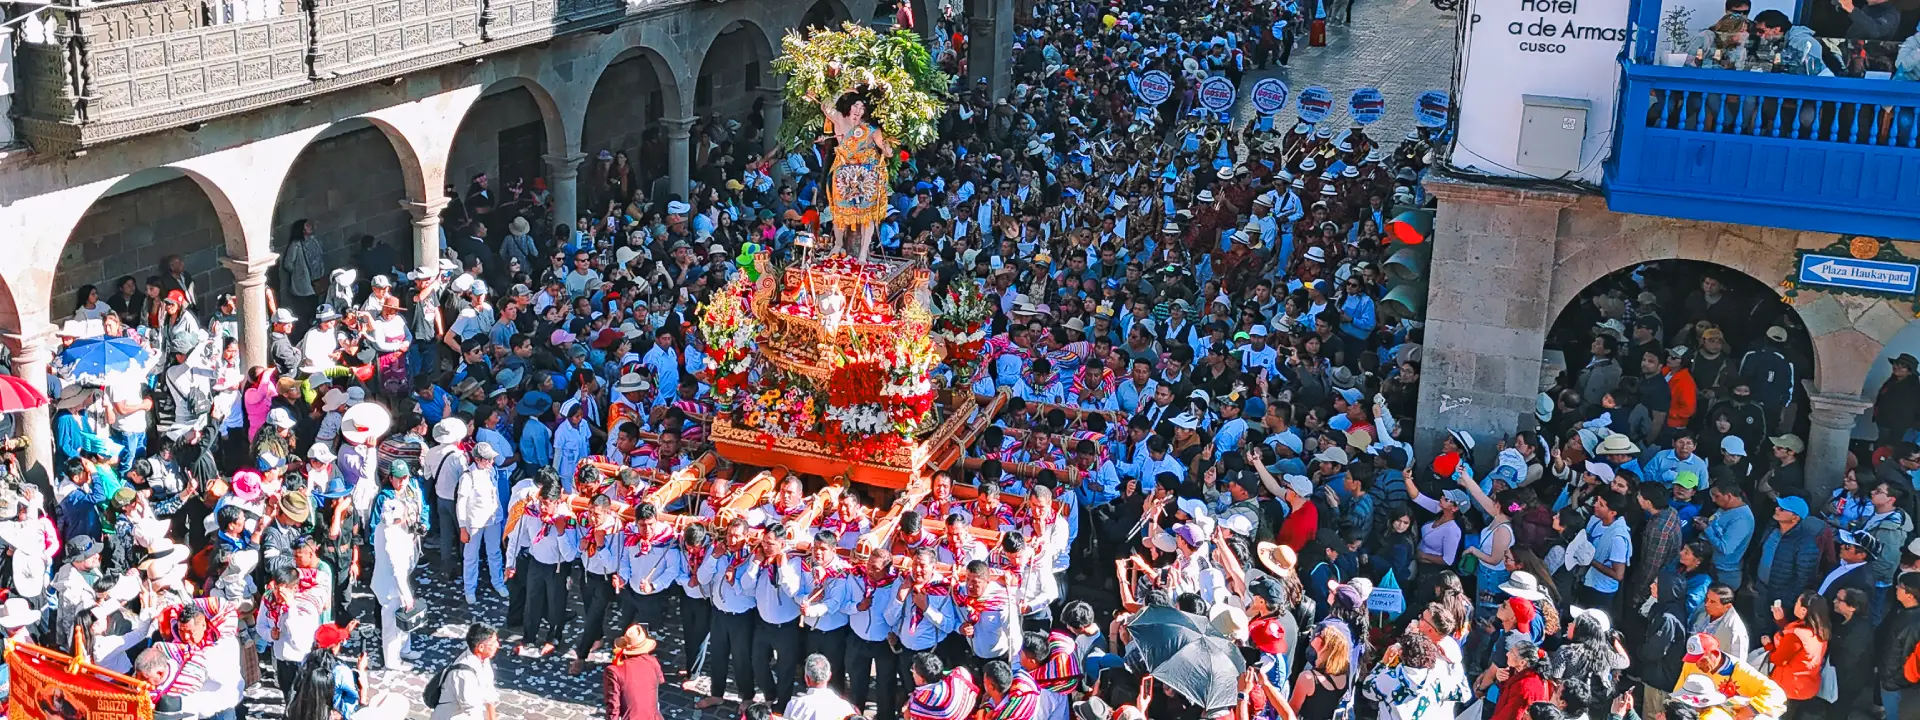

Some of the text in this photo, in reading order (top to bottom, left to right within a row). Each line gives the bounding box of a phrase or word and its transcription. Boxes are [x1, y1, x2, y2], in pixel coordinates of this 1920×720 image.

[1520, 0, 1577, 14] Hotel
[1527, 17, 1557, 36] de
[1561, 20, 1627, 42] Armas
[1821, 264, 1910, 283] Plaza Haukaypata
